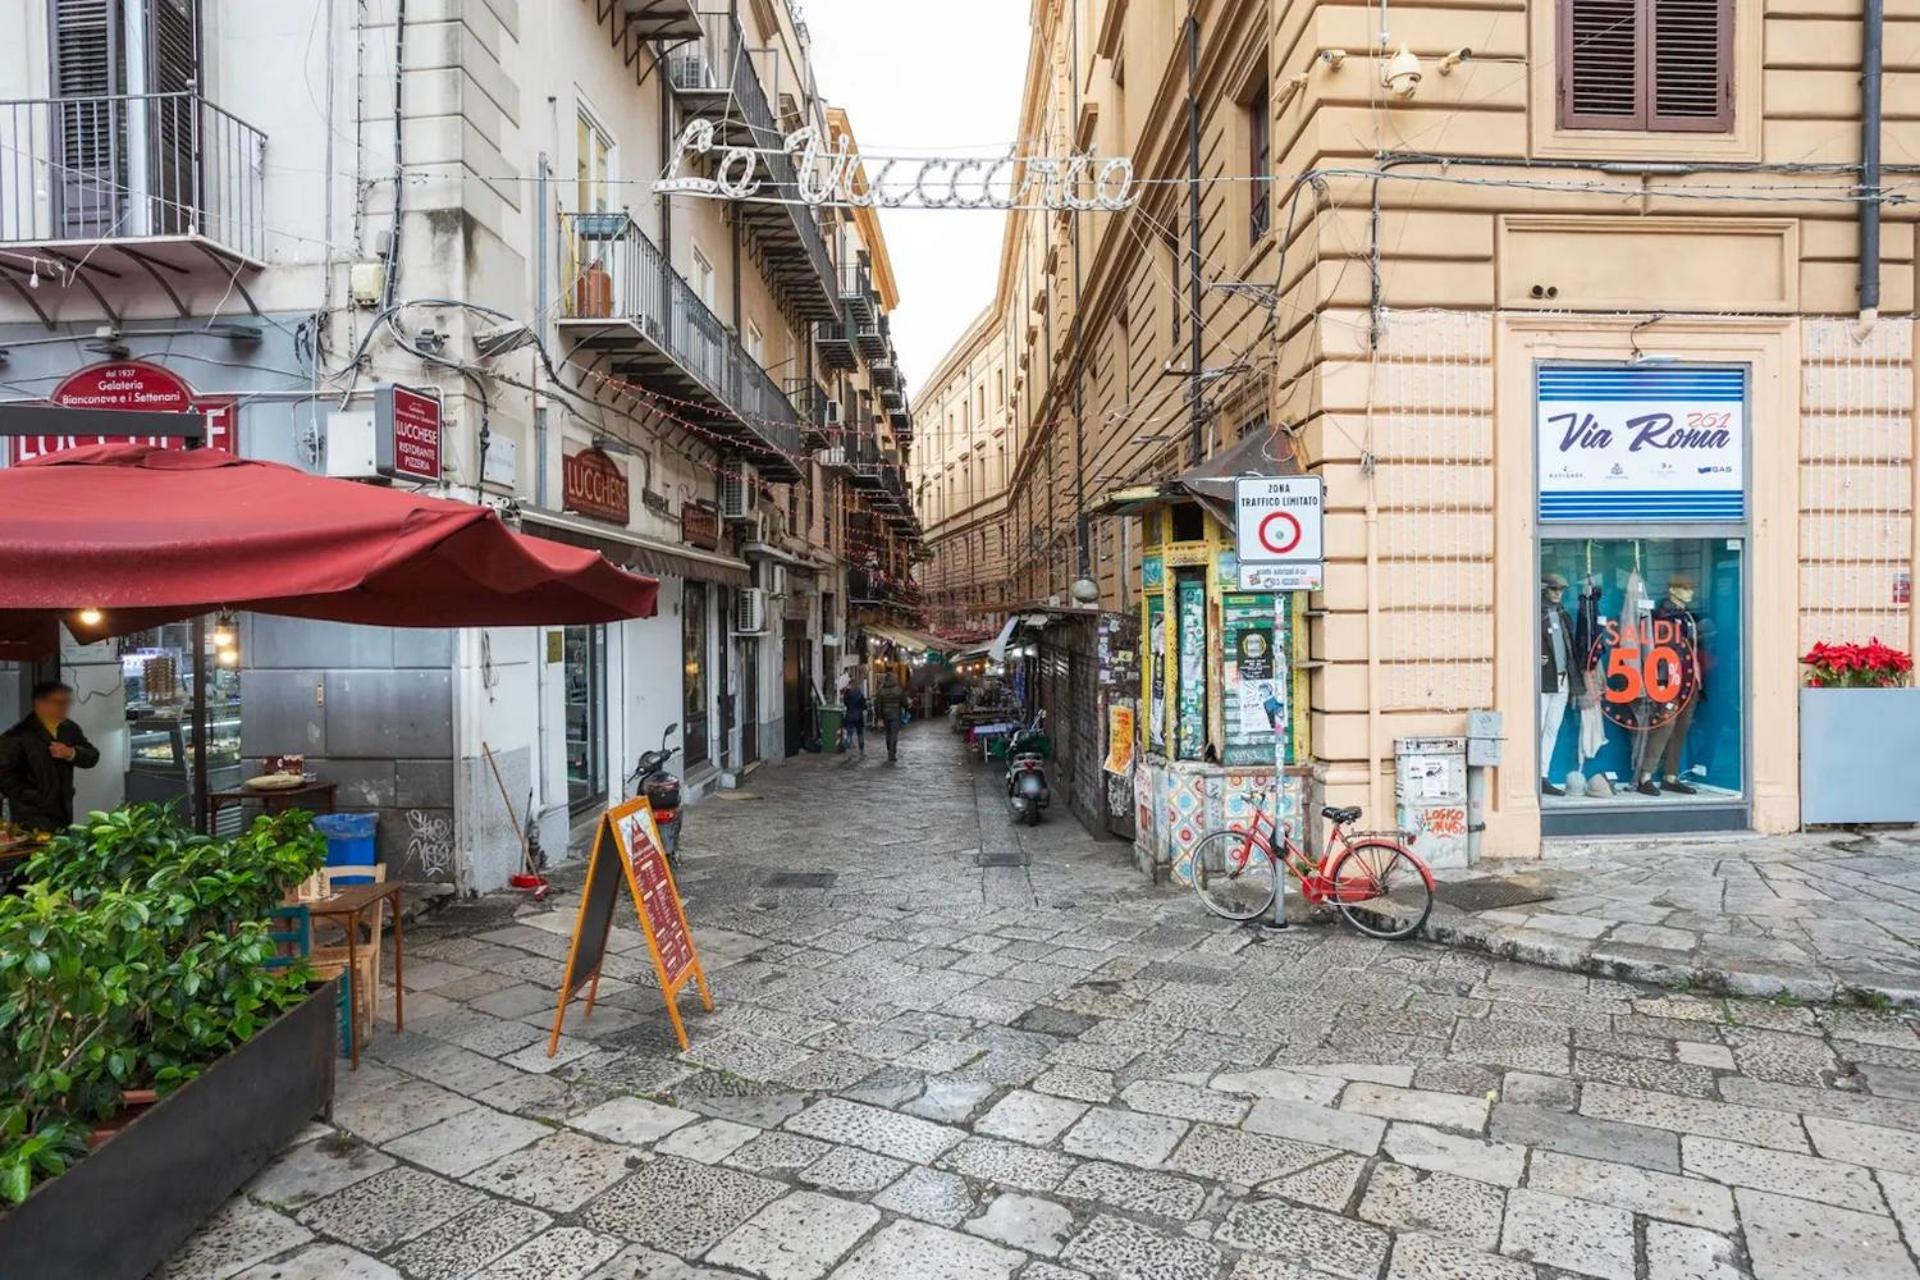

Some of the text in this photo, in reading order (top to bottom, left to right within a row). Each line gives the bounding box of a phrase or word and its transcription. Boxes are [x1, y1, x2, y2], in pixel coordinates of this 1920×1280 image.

[652, 118, 1140, 211] La Vucciria
[105, 368, 137, 378] dal 1937
[127, 392, 132, 403] i
[396, 419, 438, 446] LUCCHESE
[1547, 412, 1731, 452] Via Roma
[1710, 465, 1733, 474] GAS
[567, 461, 627, 511] LUCCHESE
[1267, 483, 1291, 494] ZONA
[1241, 496, 1318, 507] TRAFFICO LIMITATO
[1605, 619, 1683, 646] SALDI
